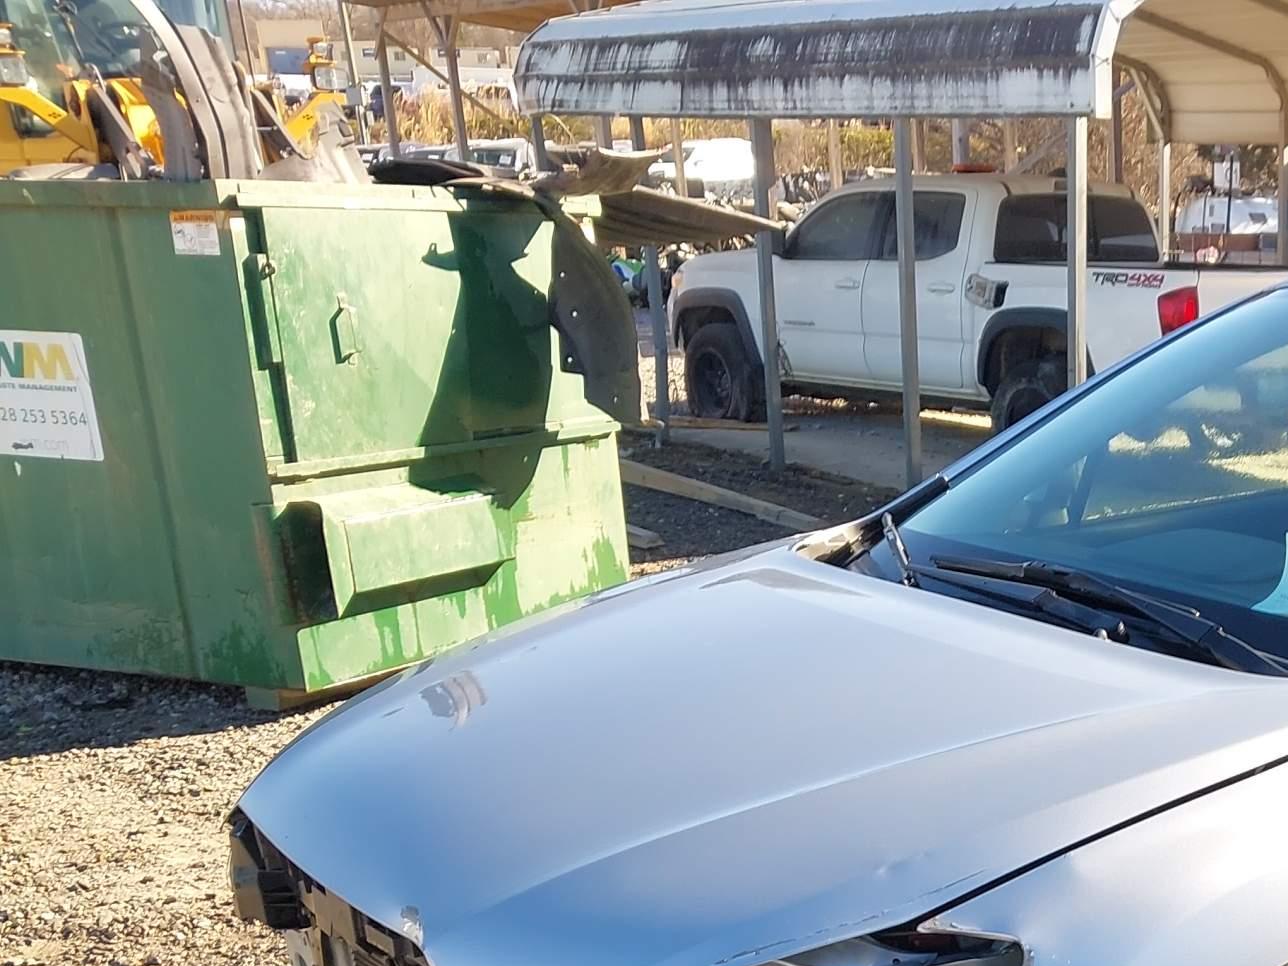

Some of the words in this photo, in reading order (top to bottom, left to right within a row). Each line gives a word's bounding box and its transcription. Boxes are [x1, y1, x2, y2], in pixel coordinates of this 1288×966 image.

[18, 384, 77, 392] MANAGEMENT
[20, 408, 46, 424] 253
[50, 410, 88, 426] 5364
